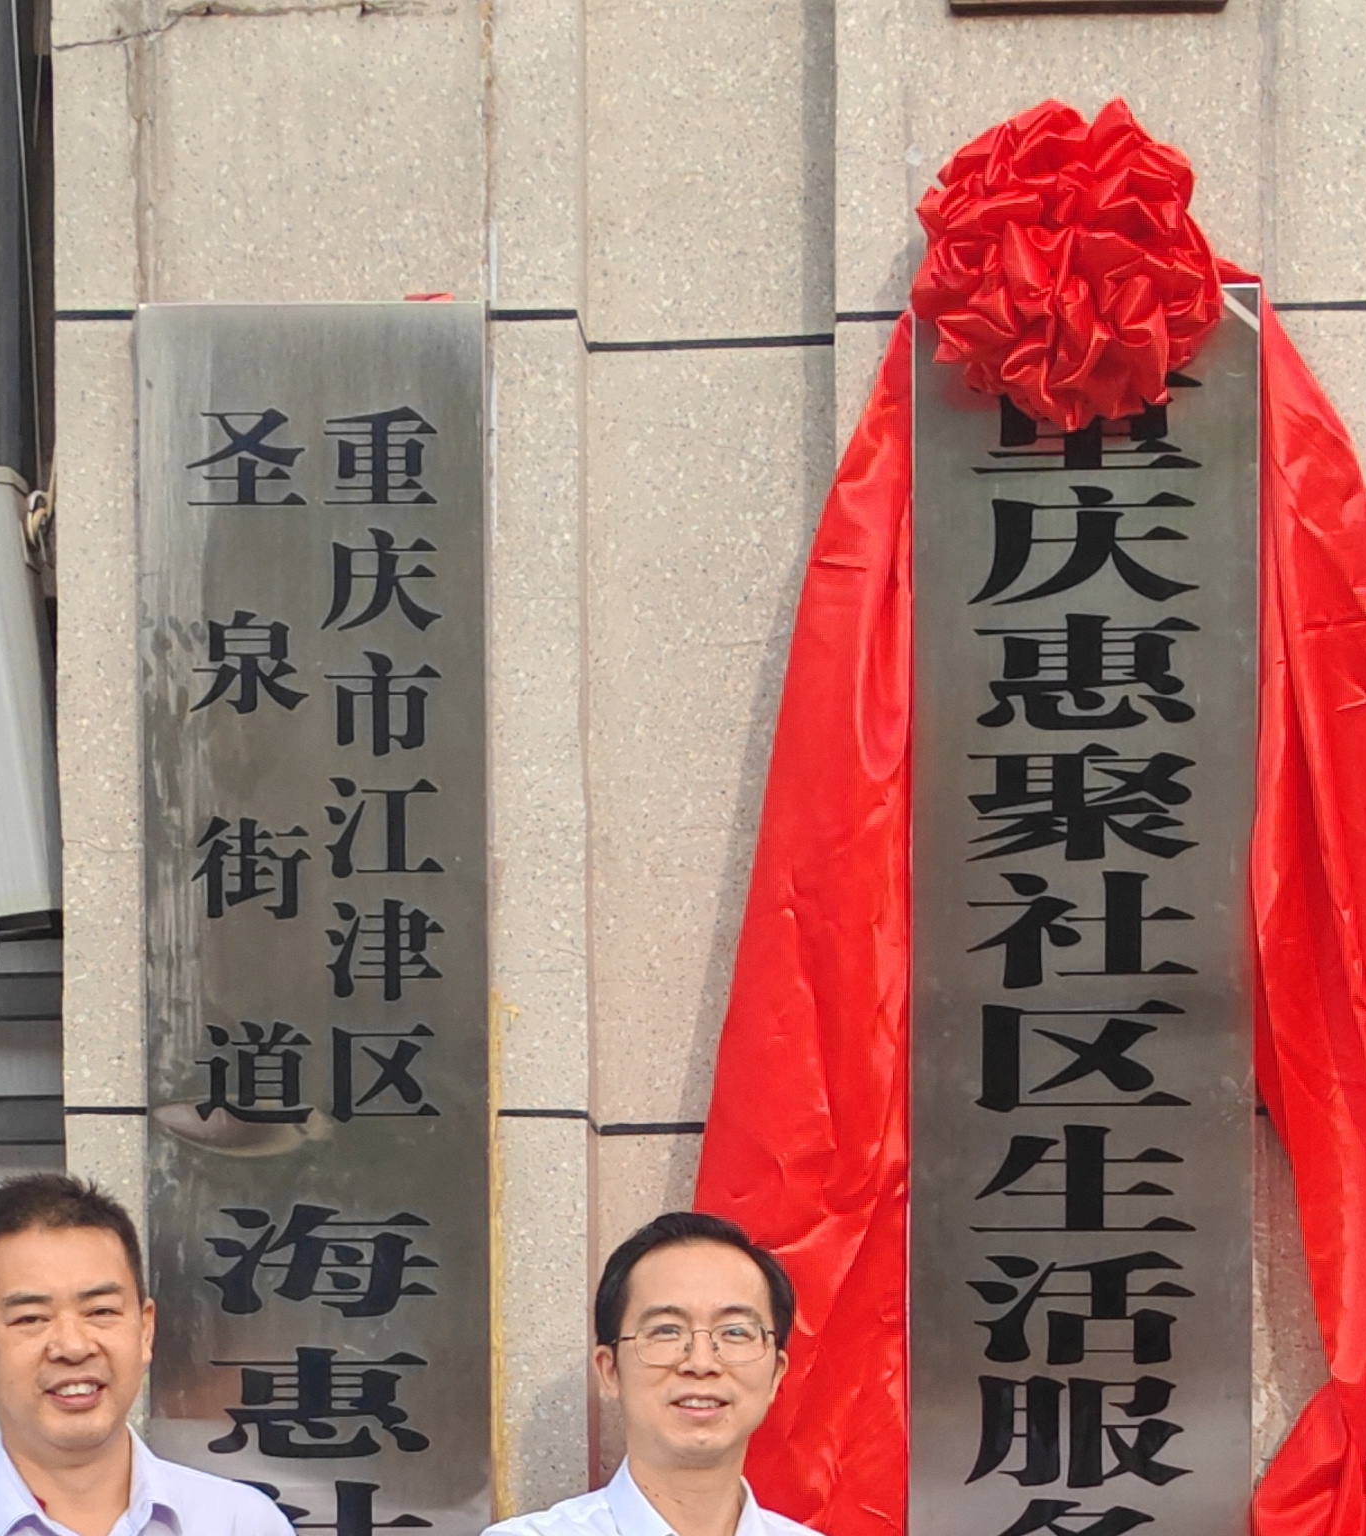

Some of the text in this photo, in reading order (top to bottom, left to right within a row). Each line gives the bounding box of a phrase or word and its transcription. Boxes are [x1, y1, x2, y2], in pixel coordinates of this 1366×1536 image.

[186, 406, 313, 1124] 圣泉街道
[322, 406, 445, 1122] 重庆市江津区
